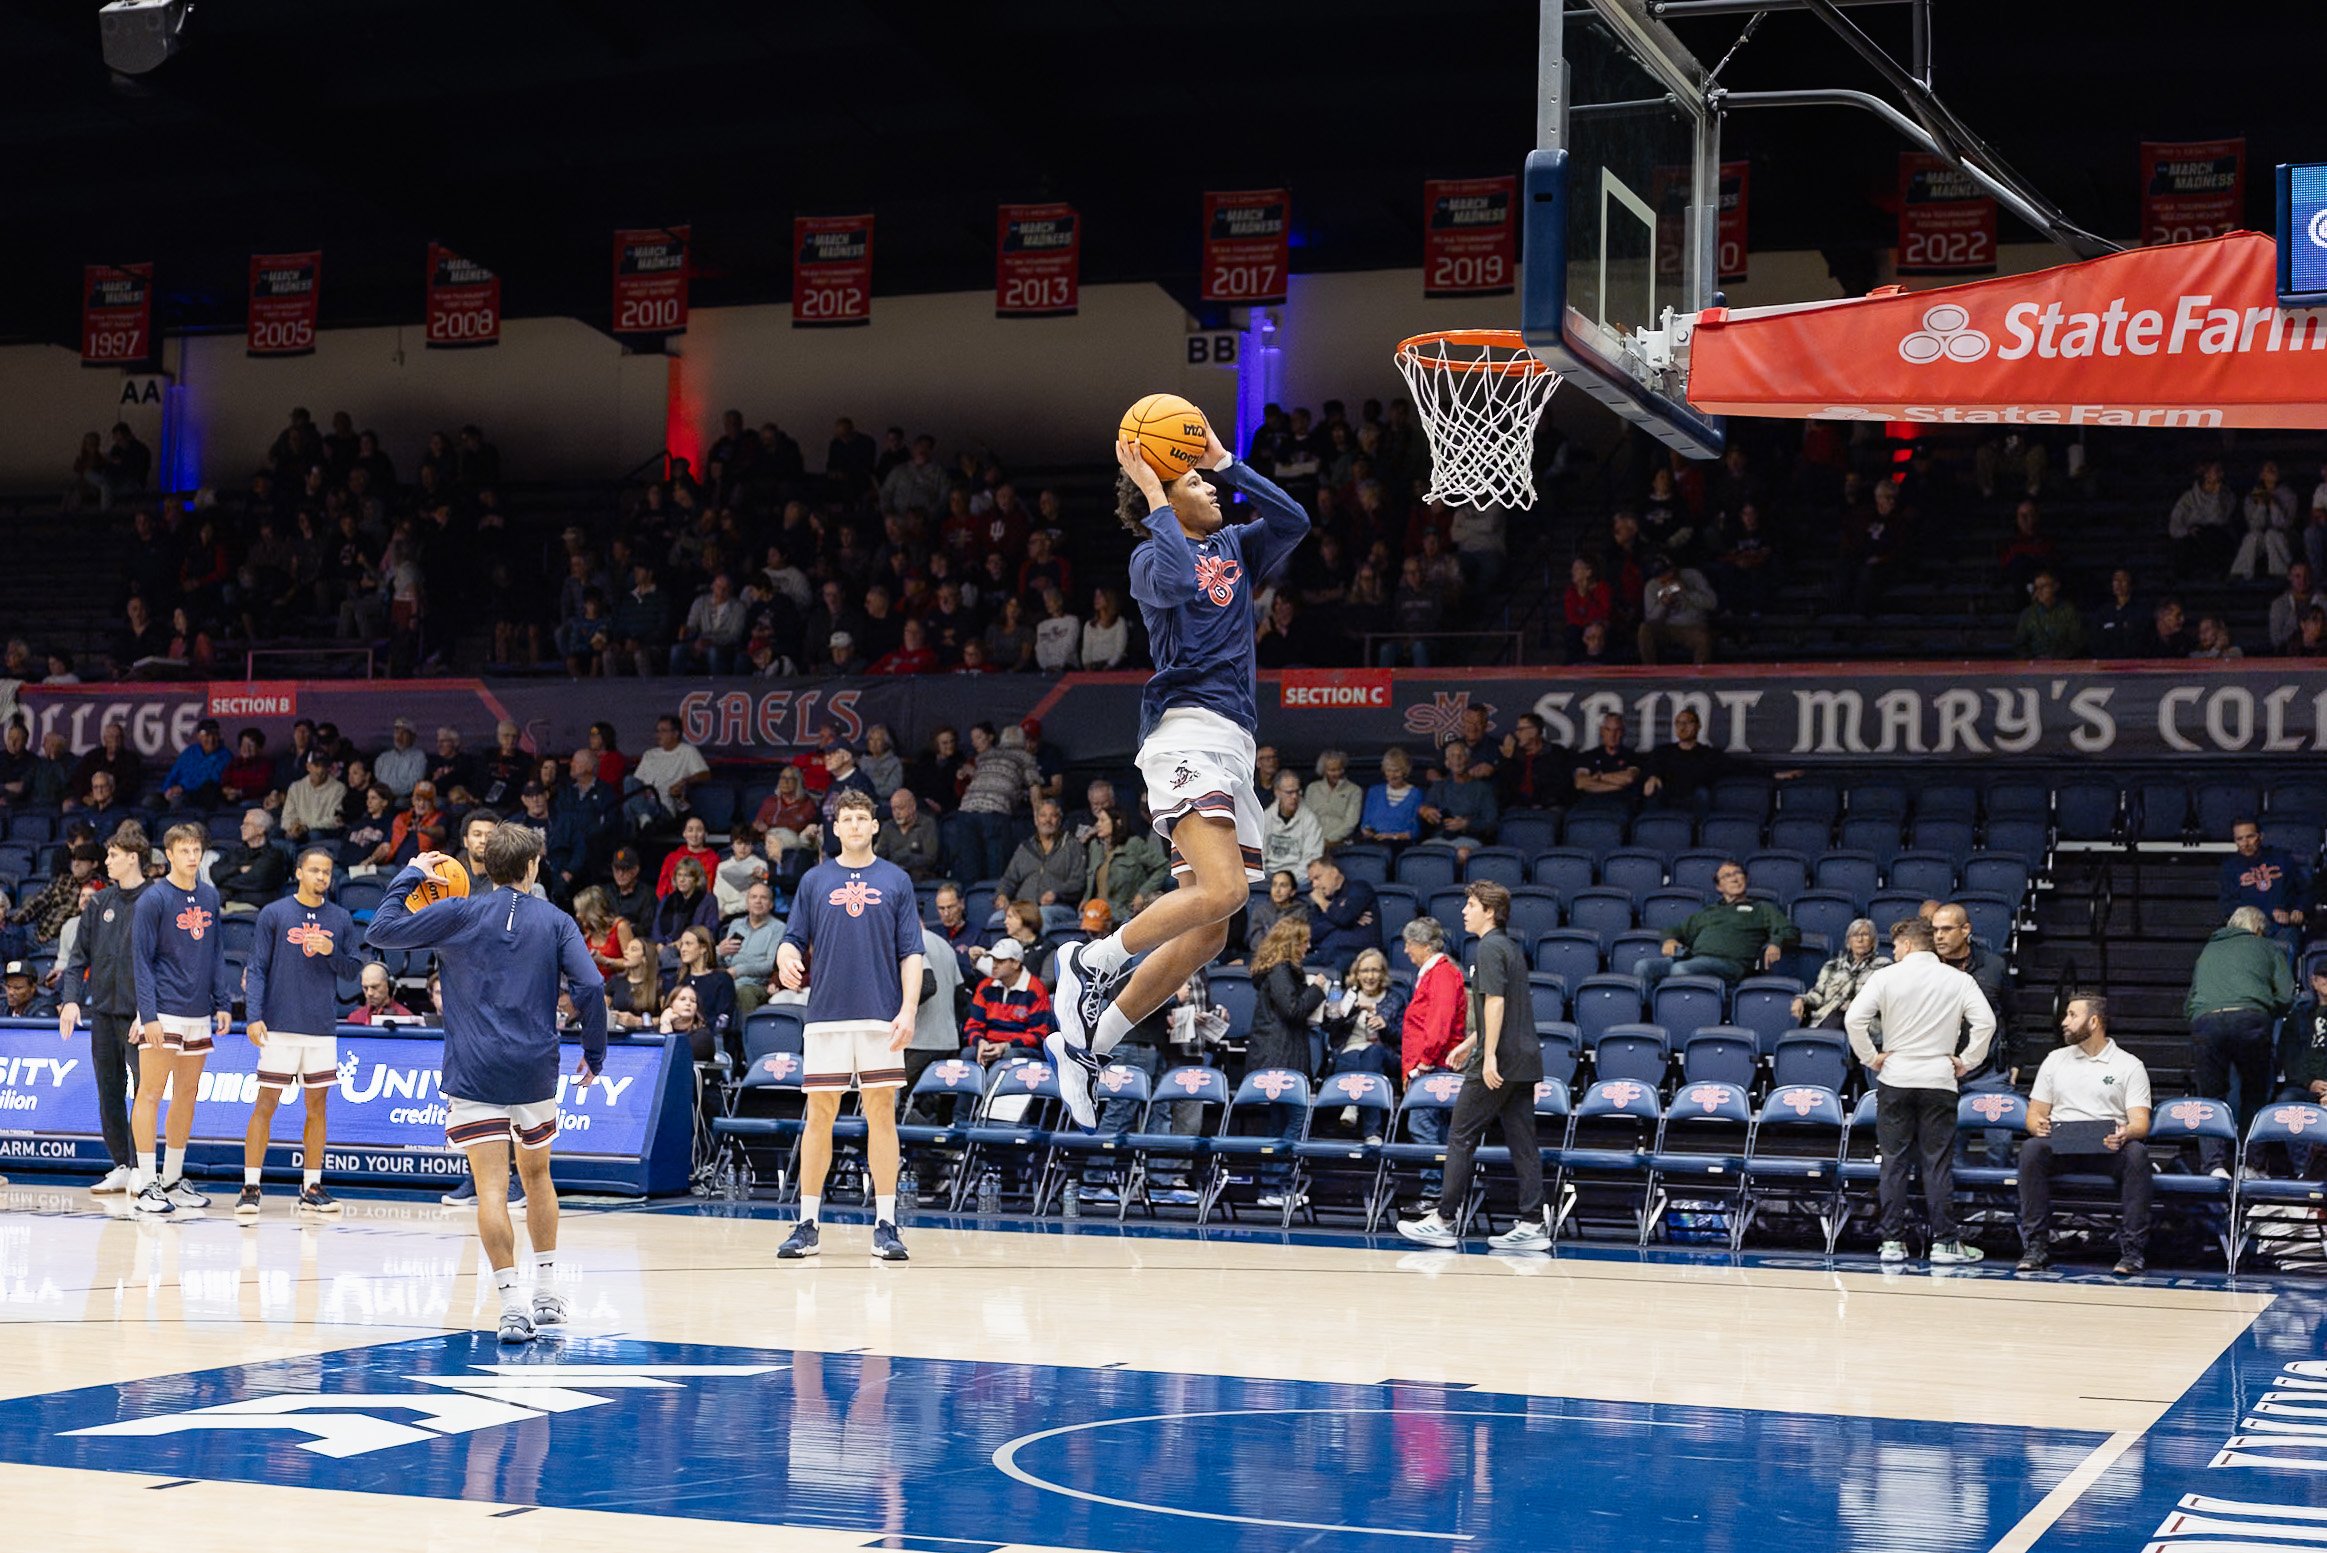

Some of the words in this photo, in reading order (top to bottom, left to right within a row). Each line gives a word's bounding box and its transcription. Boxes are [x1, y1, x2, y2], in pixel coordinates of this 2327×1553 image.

[1926, 171, 1968, 185] MARC
[2168, 162, 2214, 177] MARCH
[2173, 172, 2235, 189] MADNESS
[1905, 230, 1988, 263] 2022
[1212, 265, 1277, 295] 2017
[1434, 254, 1504, 286] 2019
[802, 288, 861, 316] 2012
[1005, 276, 1069, 306] 2013
[432, 308, 494, 338] 2008
[620, 298, 679, 328] 2010
[90, 330, 141, 357] 1997
[253, 319, 313, 347] 2005
[1188, 336, 1237, 364] BB
[120, 380, 161, 404] AA
[211, 697, 275, 715] SECTION
[278, 698, 290, 714] B
[1285, 687, 1367, 705] SECTION
[1370, 687, 1385, 704] C
[678, 690, 863, 746] GAELS
[1531, 690, 1764, 753] SAINT
[1789, 680, 2118, 754] MARY'S
[2157, 685, 2327, 751] COL
[389, 1102, 447, 1126] credit
[0, 1141, 77, 1158] ARM.COM
[291, 1152, 360, 1172] DEND
[365, 1155, 414, 1173] YOUR
